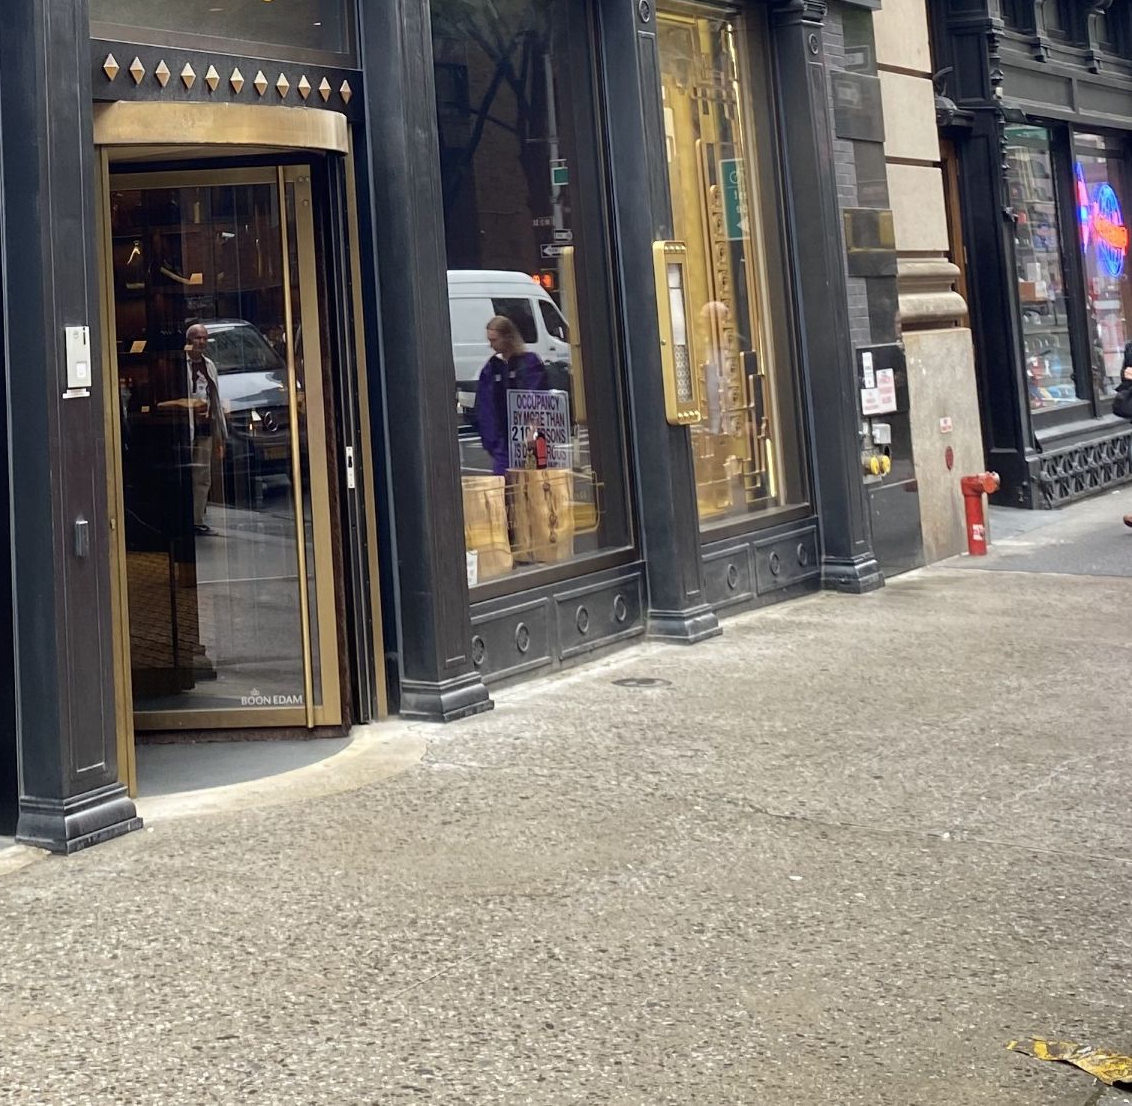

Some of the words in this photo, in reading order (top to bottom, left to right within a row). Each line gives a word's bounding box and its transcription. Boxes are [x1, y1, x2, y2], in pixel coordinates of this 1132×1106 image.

[516, 394, 560, 410] OCCUPANCY
[513, 411, 523, 425] BY
[523, 412, 545, 426] MORE
[545, 412, 565, 427] THAN
[241, 695, 272, 705] BOON
[273, 695, 303, 704] EDAM
